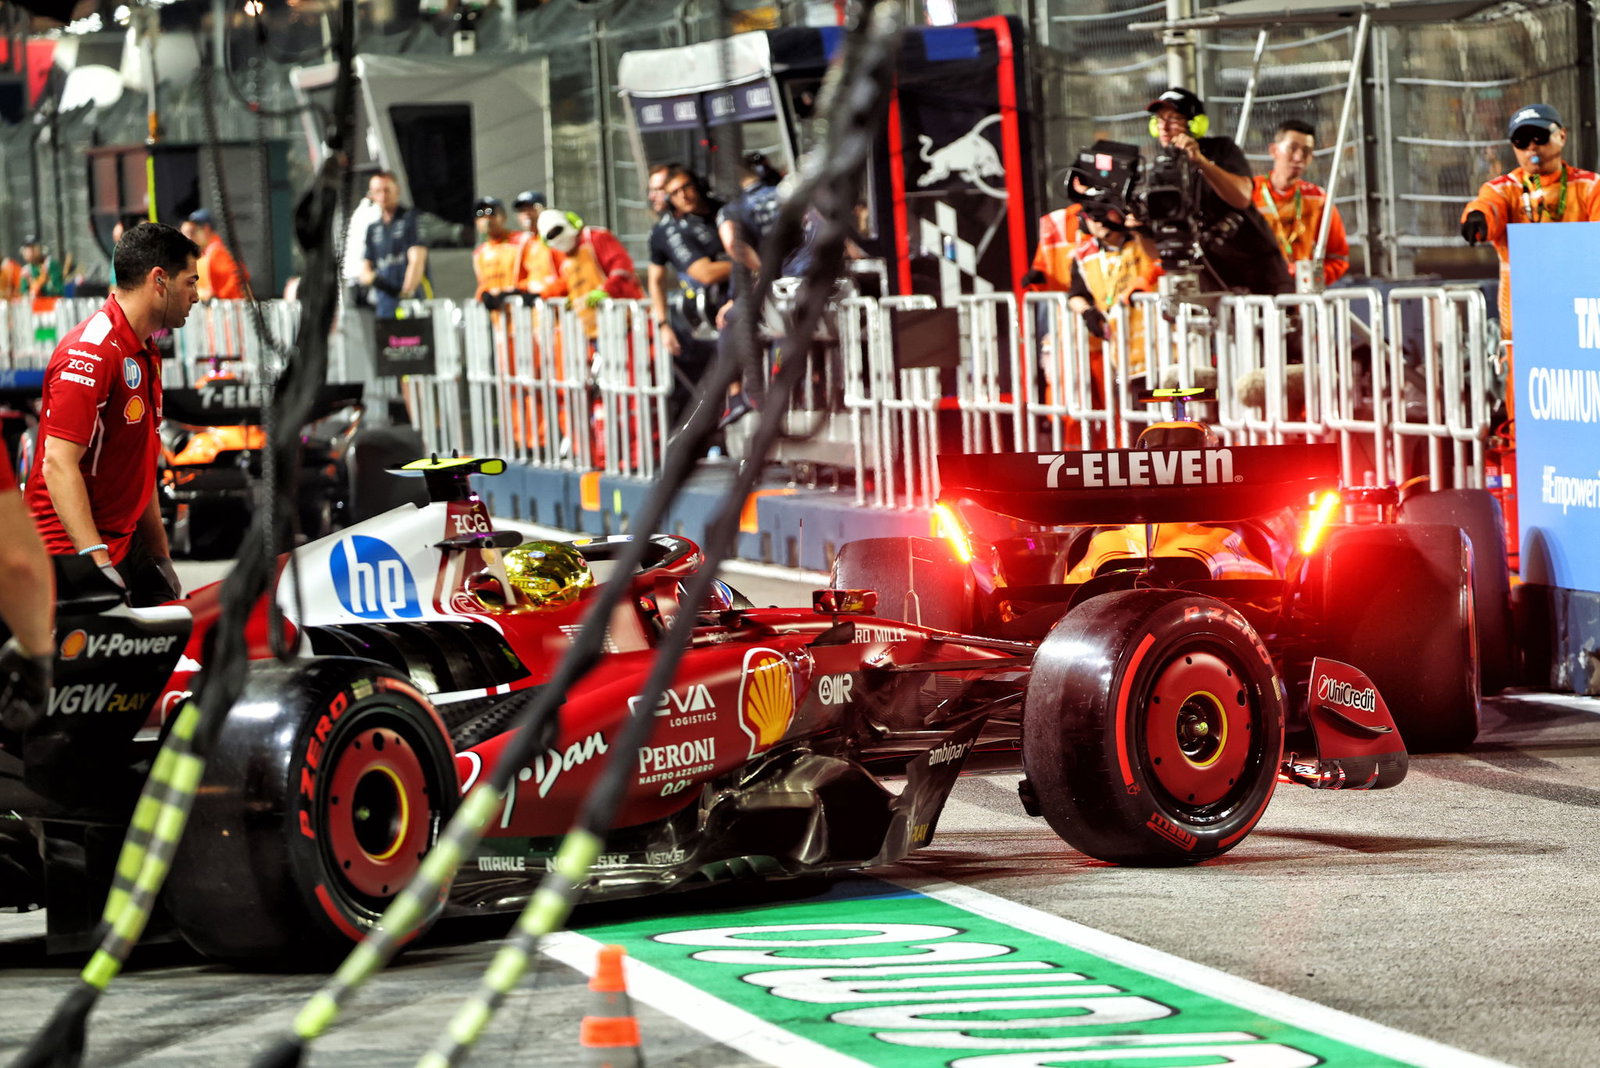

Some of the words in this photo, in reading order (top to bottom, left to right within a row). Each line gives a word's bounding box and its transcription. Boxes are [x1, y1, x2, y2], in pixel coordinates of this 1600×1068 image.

[1573, 297, 1600, 349] TA
[67, 358, 95, 374] ZCG
[1528, 367, 1600, 423] COMMUN
[451, 514, 490, 533] ZCG
[1184, 606, 1200, 623] P
[86, 633, 178, 659] V-Power
[874, 628, 907, 643] MILLE
[46, 683, 118, 717] VGW
[1328, 678, 1376, 712] UniCredit
[670, 712, 717, 728] LOGISTICS
[301, 691, 349, 801] ZERO
[638, 737, 716, 774] PERONI
[928, 741, 967, 766] ambipar
[638, 771, 674, 785] NASTRO
[675, 763, 714, 778] AZZURRO
[478, 856, 526, 871] MAHLE
